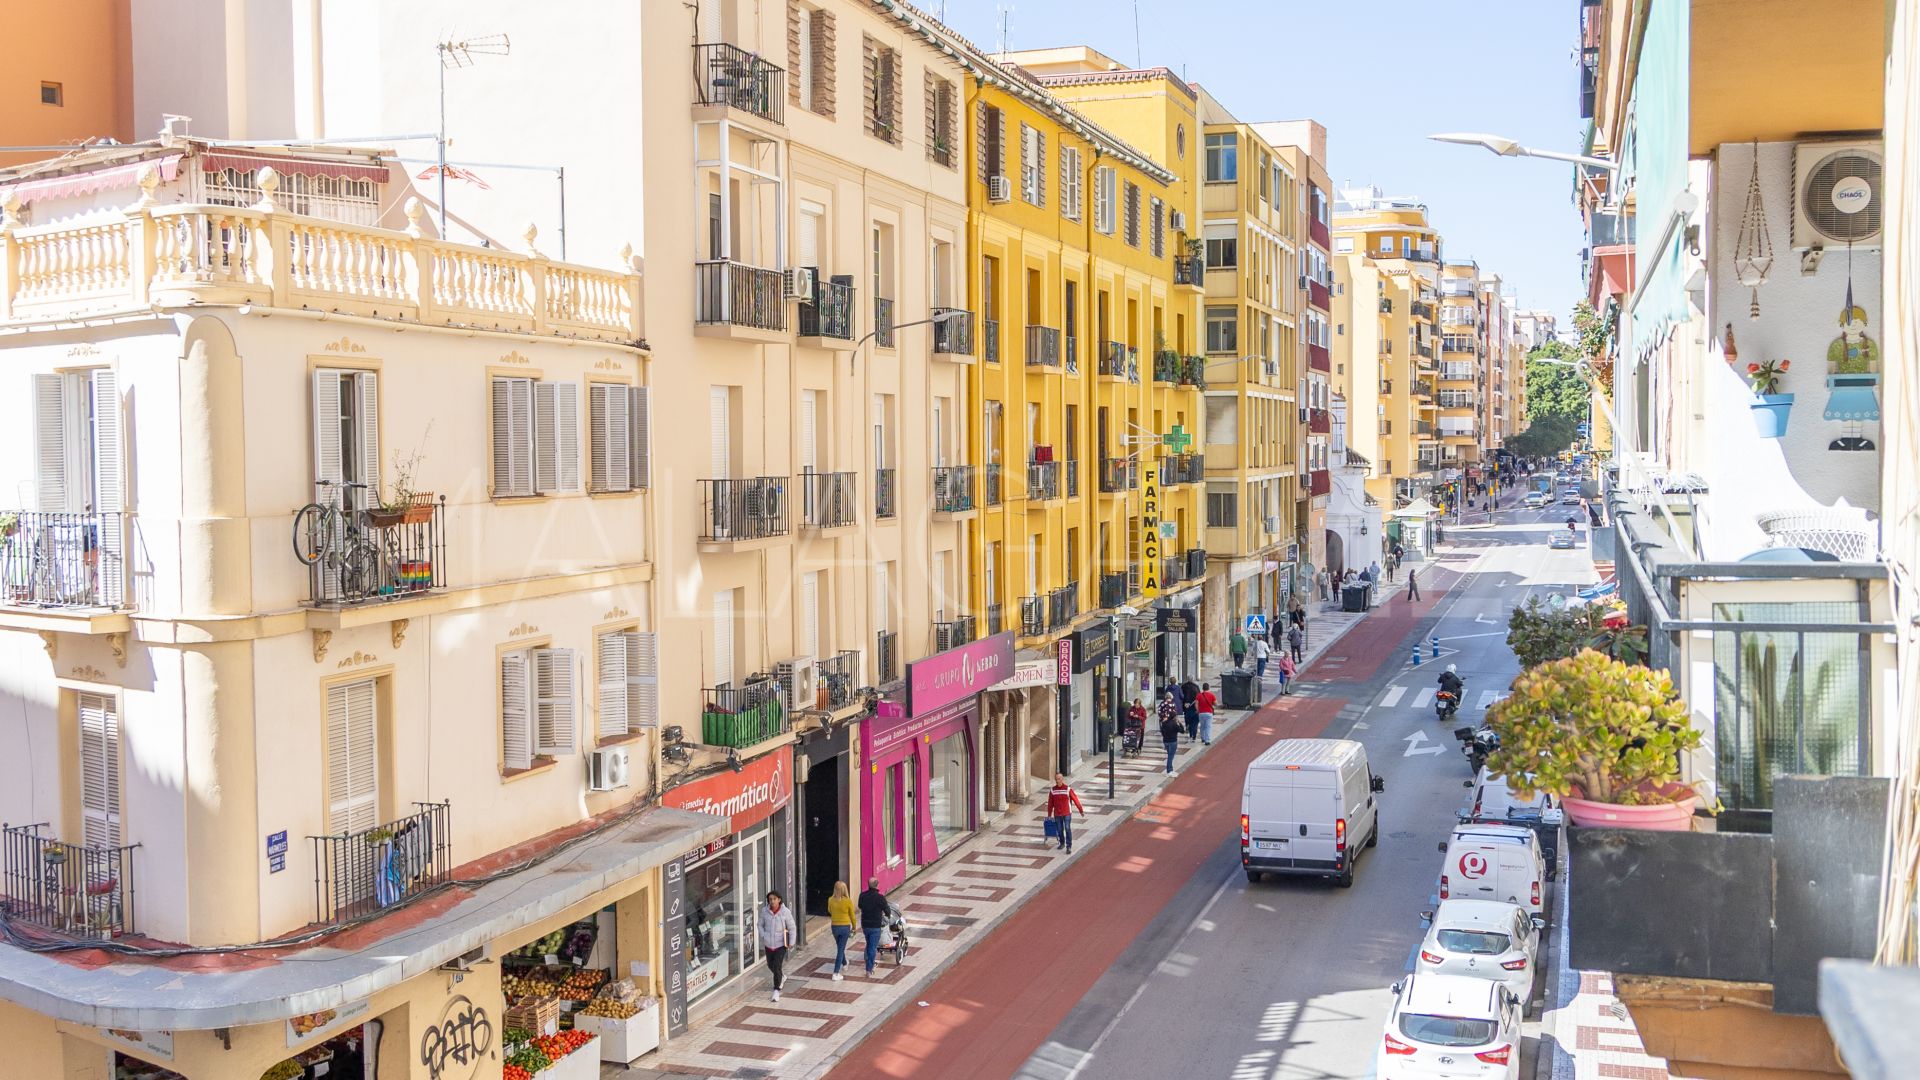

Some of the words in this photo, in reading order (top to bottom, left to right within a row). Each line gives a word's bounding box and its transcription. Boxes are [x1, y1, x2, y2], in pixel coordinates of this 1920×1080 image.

[1839, 191, 1862, 199] CHAOS
[1143, 470, 1158, 589] FARMACIA
[934, 667, 960, 689] GRUPO
[976, 654, 999, 673] NEBRO
[1061, 641, 1069, 684] OBRADOR
[694, 781, 768, 817] formática
